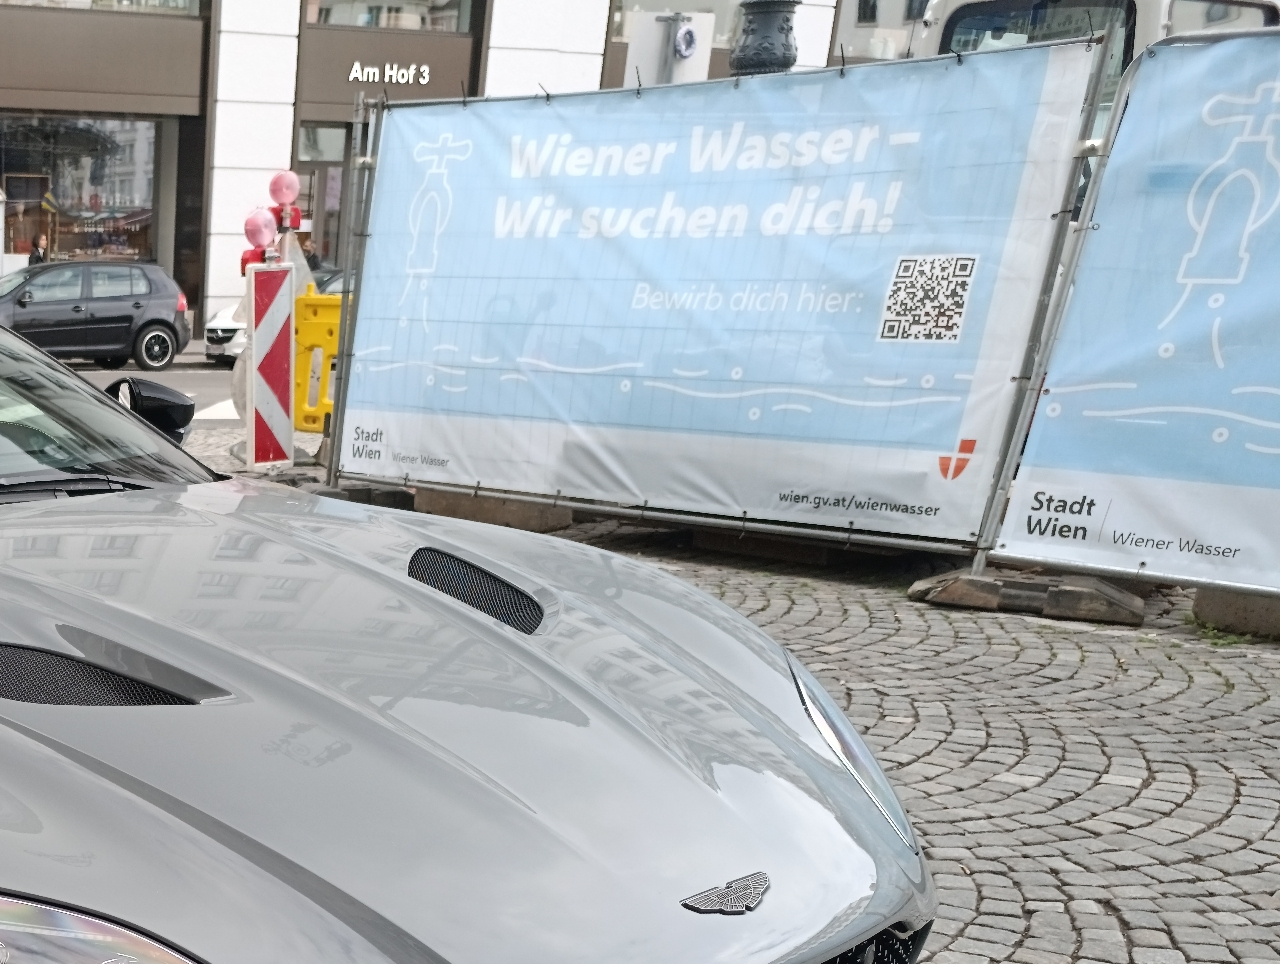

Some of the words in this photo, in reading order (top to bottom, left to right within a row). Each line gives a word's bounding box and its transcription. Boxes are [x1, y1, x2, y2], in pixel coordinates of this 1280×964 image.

[348, 61, 380, 83] Am
[383, 62, 418, 84] Hof
[418, 64, 430, 85] 3
[509, 132, 678, 179] Wiener
[688, 121, 881, 174] Wasser
[494, 193, 574, 240] Wir
[577, 191, 750, 239] suchen
[759, 181, 904, 237] dich!
[632, 282, 722, 312] Bewirb
[729, 284, 790, 313] dich
[797, 286, 864, 314] hier:
[354, 426, 384, 443] Stadt
[352, 444, 381, 460] Wien
[392, 452, 419, 464] Wiener
[421, 455, 450, 467] Wasser
[779, 490, 940, 517] wien.gv.at/wienwasser
[1030, 491, 1096, 516] Stadt
[1026, 515, 1087, 540] Wien
[1112, 530, 1174, 550] Wiener
[1179, 537, 1241, 559] Wasser
